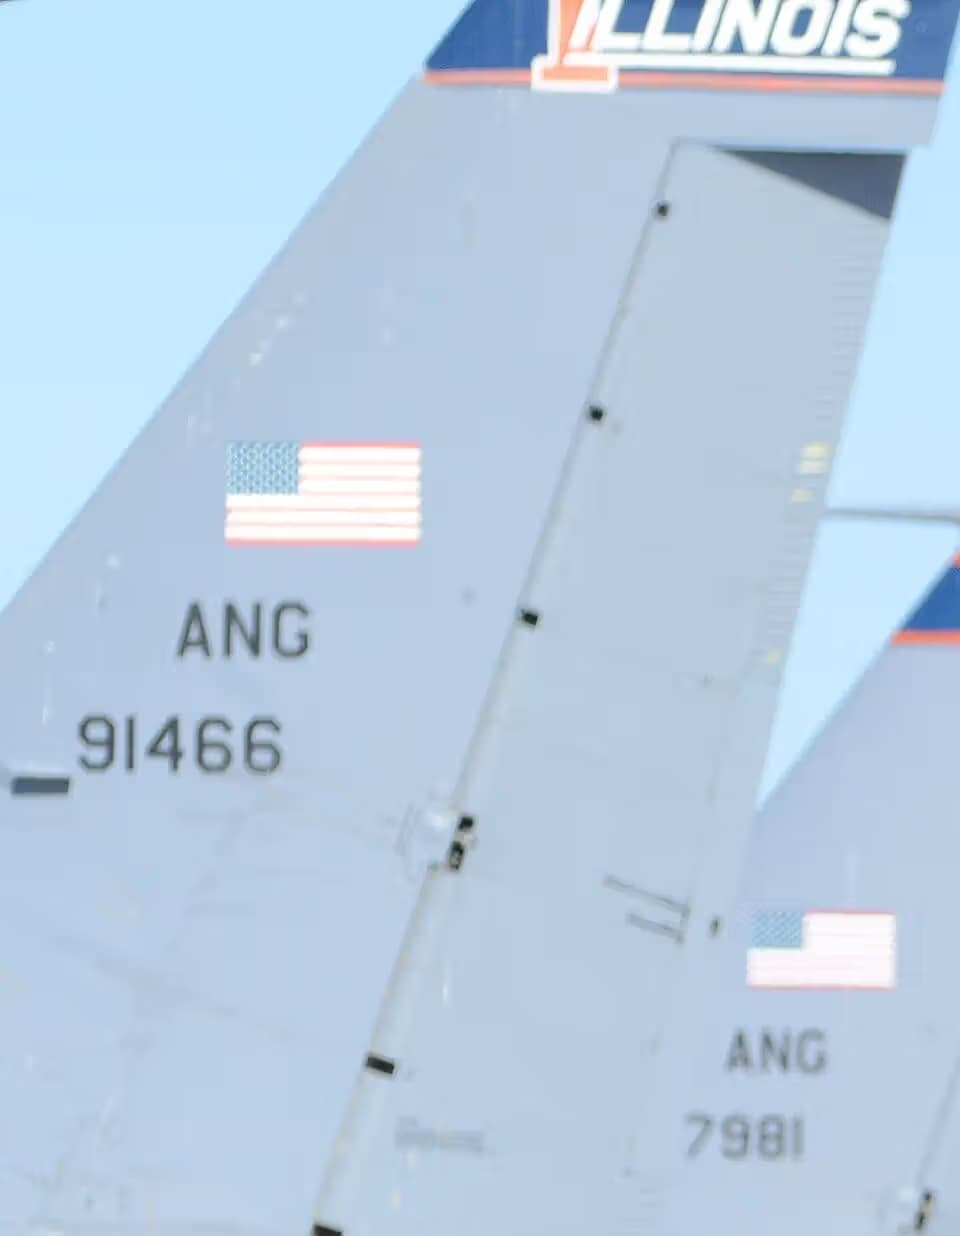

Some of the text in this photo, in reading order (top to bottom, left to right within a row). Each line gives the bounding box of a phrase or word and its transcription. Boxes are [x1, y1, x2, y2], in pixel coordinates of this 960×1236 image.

[535, 0, 909, 80] ILLINOIS
[176, 601, 312, 660] ANG
[77, 713, 283, 774] 91466
[726, 1026, 829, 1075] ANG
[685, 1112, 805, 1161] 7981
